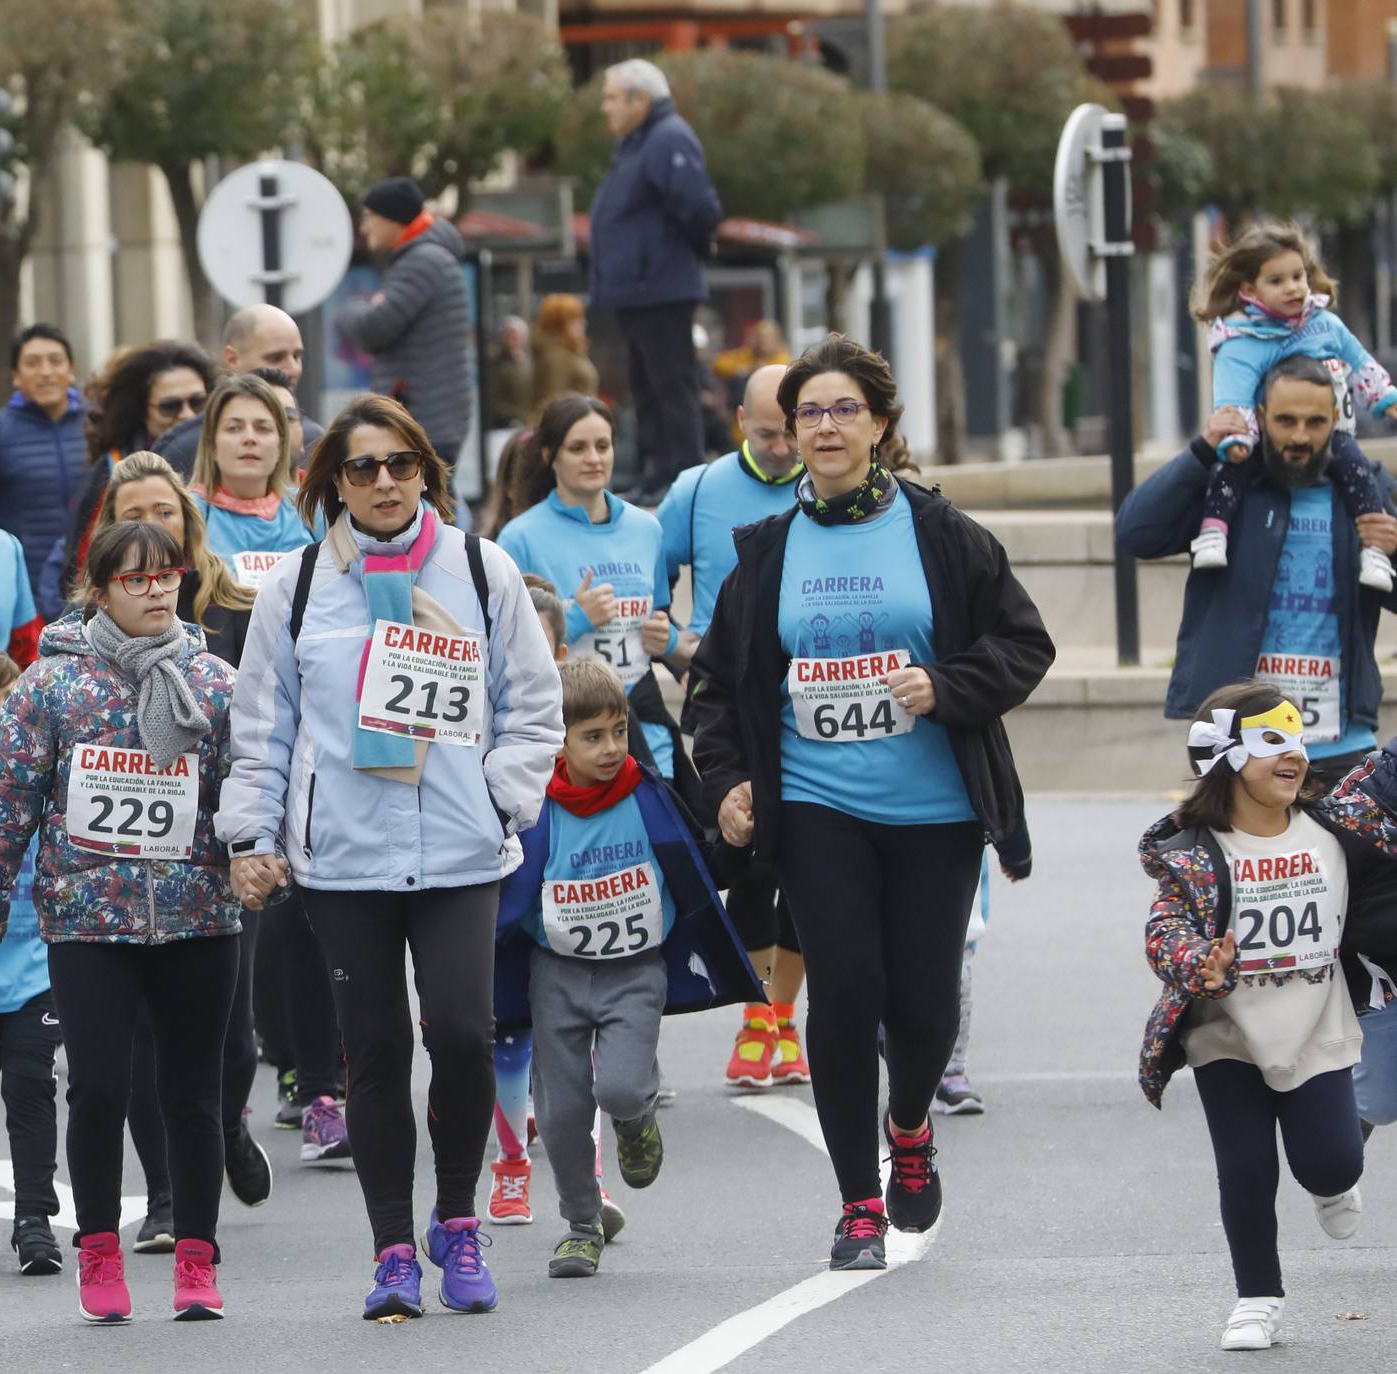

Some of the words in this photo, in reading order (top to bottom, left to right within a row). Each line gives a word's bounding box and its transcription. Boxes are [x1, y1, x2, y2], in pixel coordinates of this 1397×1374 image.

[801, 576, 885, 595] CARRERA
[384, 625, 481, 662] CARRERA
[387, 660, 396, 668] LA
[397, 662, 412, 671] VIDA
[450, 672, 459, 680] DE
[388, 652, 401, 660] POR
[402, 654, 410, 662] LA
[449, 664, 458, 672] LA
[797, 653, 900, 682] CARRERA
[1257, 655, 1333, 678] ARRERA
[384, 674, 471, 723] 213
[813, 699, 897, 739] 644
[86, 774, 99, 782] POR
[156, 779, 181, 788] FAMILIA
[111, 784, 147, 794] SALUDABLE
[167, 788, 186, 796] RIOJA
[87, 795, 174, 838] 229
[143, 845, 181, 853] LABORAL
[569, 840, 645, 869] CARRERA
[553, 867, 649, 904] CARRERA
[1242, 895, 1258, 904] VIDA
[1293, 889, 1302, 897] DE
[1302, 888, 1310, 896] LA
[1290, 881, 1299, 889] LA
[572, 906, 581, 914] LA
[624, 892, 646, 904] FAMILIA
[636, 898, 652, 908] RIOJA
[569, 913, 649, 957] 225
[1239, 901, 1322, 951] 204
[1299, 950, 1331, 961] LABORAL
